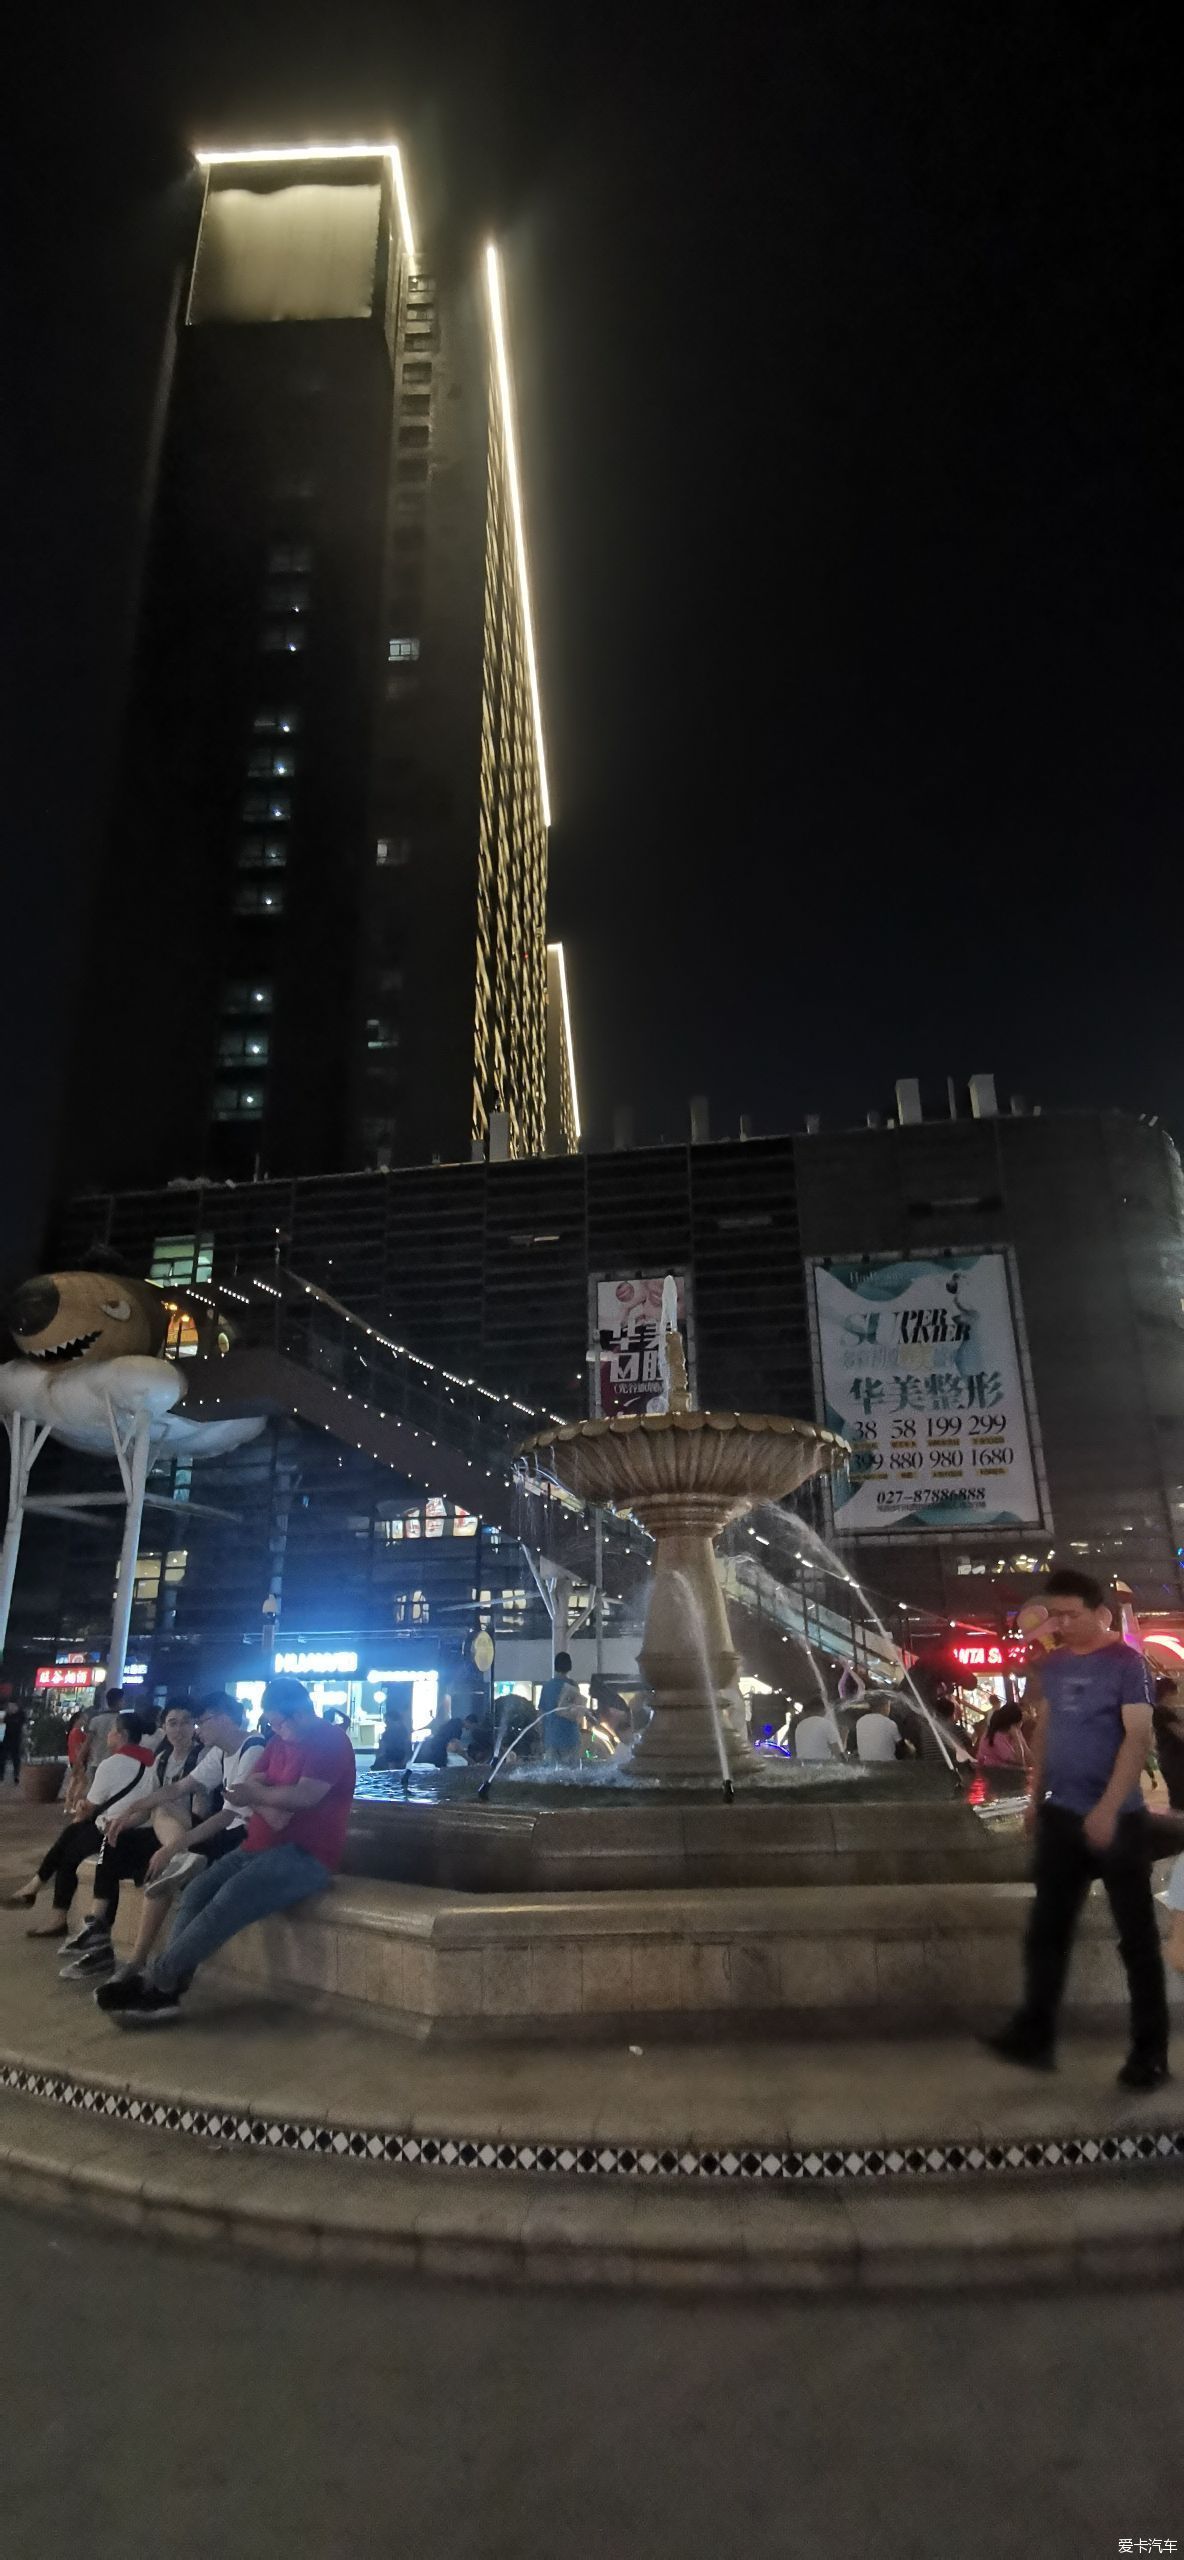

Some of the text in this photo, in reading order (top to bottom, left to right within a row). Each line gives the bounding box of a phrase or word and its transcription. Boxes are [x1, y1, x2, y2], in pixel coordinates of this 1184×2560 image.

[850, 1371, 1004, 1414] 华美整形
[852, 1414, 1007, 1440] 38 58 199 299
[890, 1452, 924, 1470] 880
[929, 1449, 963, 1468] 980
[971, 1447, 1014, 1466] 1680
